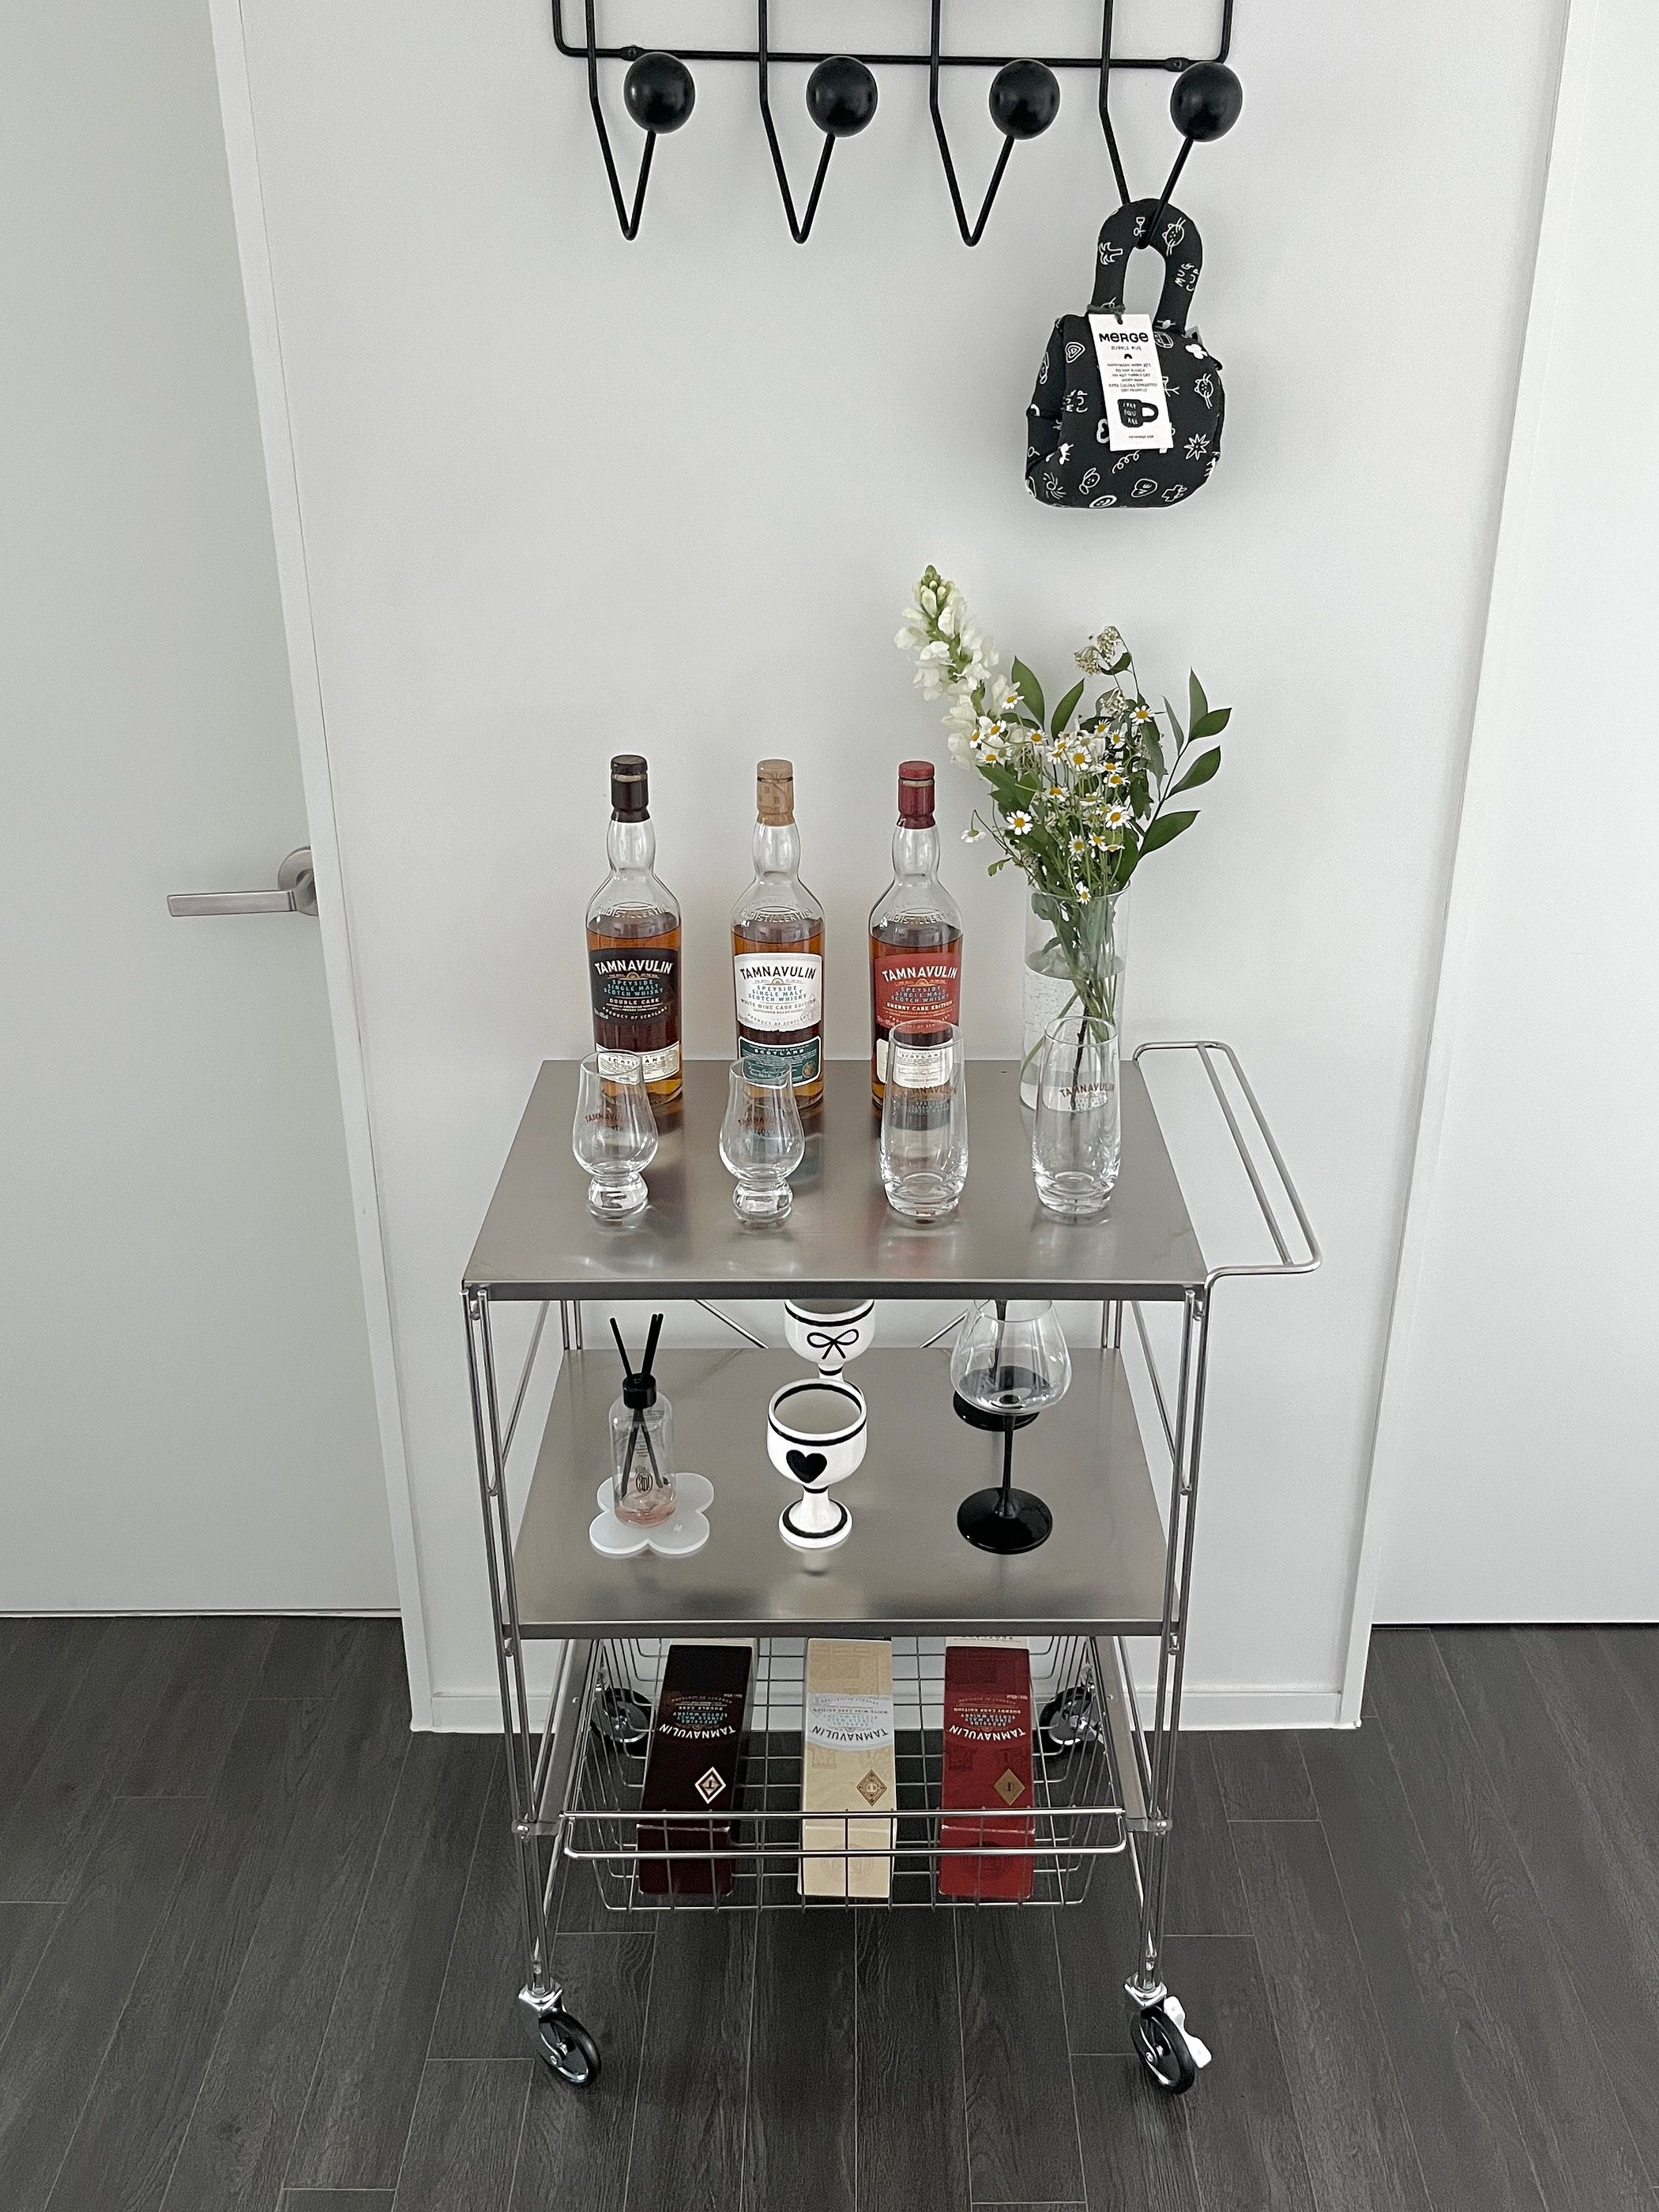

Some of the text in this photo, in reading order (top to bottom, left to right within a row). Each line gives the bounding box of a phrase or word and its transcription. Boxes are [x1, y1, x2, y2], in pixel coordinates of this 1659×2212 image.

[1175, 263, 1194, 287] MUG
[1186, 269, 1198, 292] CUP
[1076, 390, 1088, 412] CUP
[595, 960, 672, 975] TAMNAVULIN
[740, 966, 816, 980] TAMNAVULIN
[882, 965, 957, 982] TAMNAVULIN
[741, 999, 755, 1007] WHITE
[748, 993, 774, 1002] SCOTCH
[886, 1002, 909, 1010] SHERRY
[660, 1724, 735, 1739] TAMNAVULIN
[811, 1725, 888, 1741] TAMNAVULIN
[949, 1725, 1026, 1741] TAMNAVULIN
